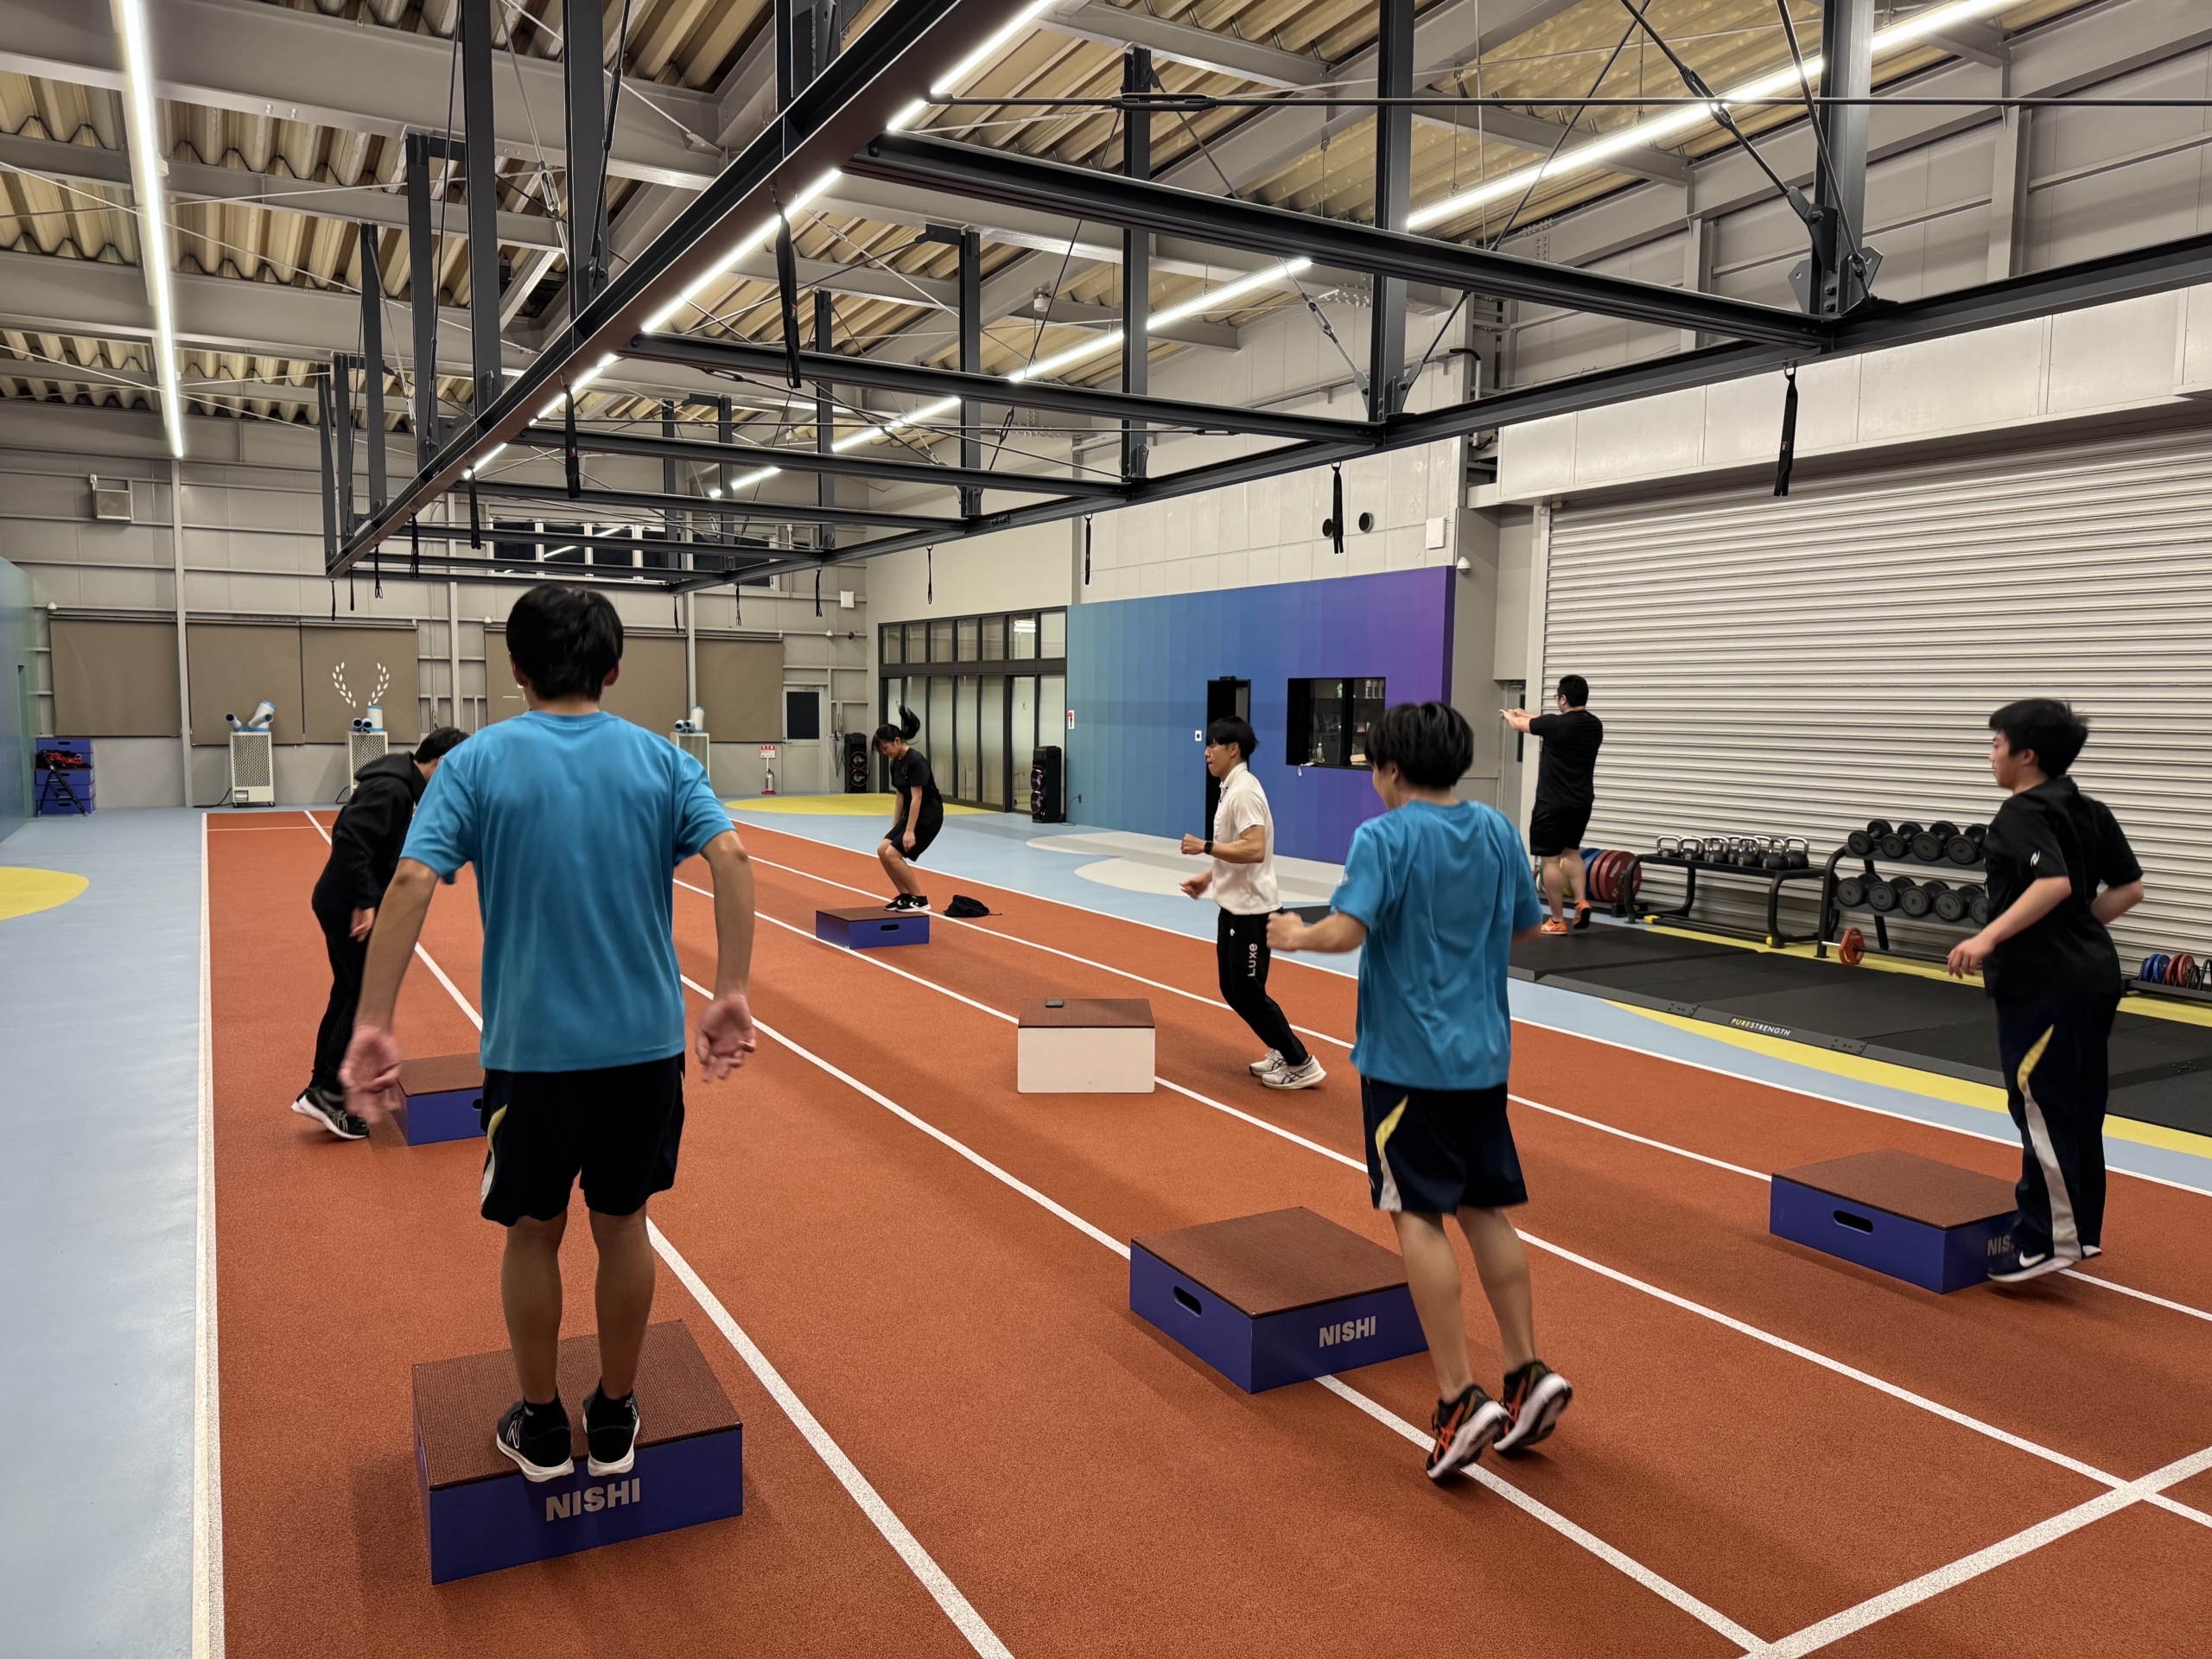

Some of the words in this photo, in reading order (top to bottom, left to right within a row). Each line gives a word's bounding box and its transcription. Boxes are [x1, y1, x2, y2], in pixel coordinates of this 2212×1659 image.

[1731, 1018, 1791, 1036] PURESTRENGTH
[1987, 1234, 2011, 1256] NIS
[1319, 1315, 1376, 1348] NISHI
[545, 1478, 640, 1522] NISHI
